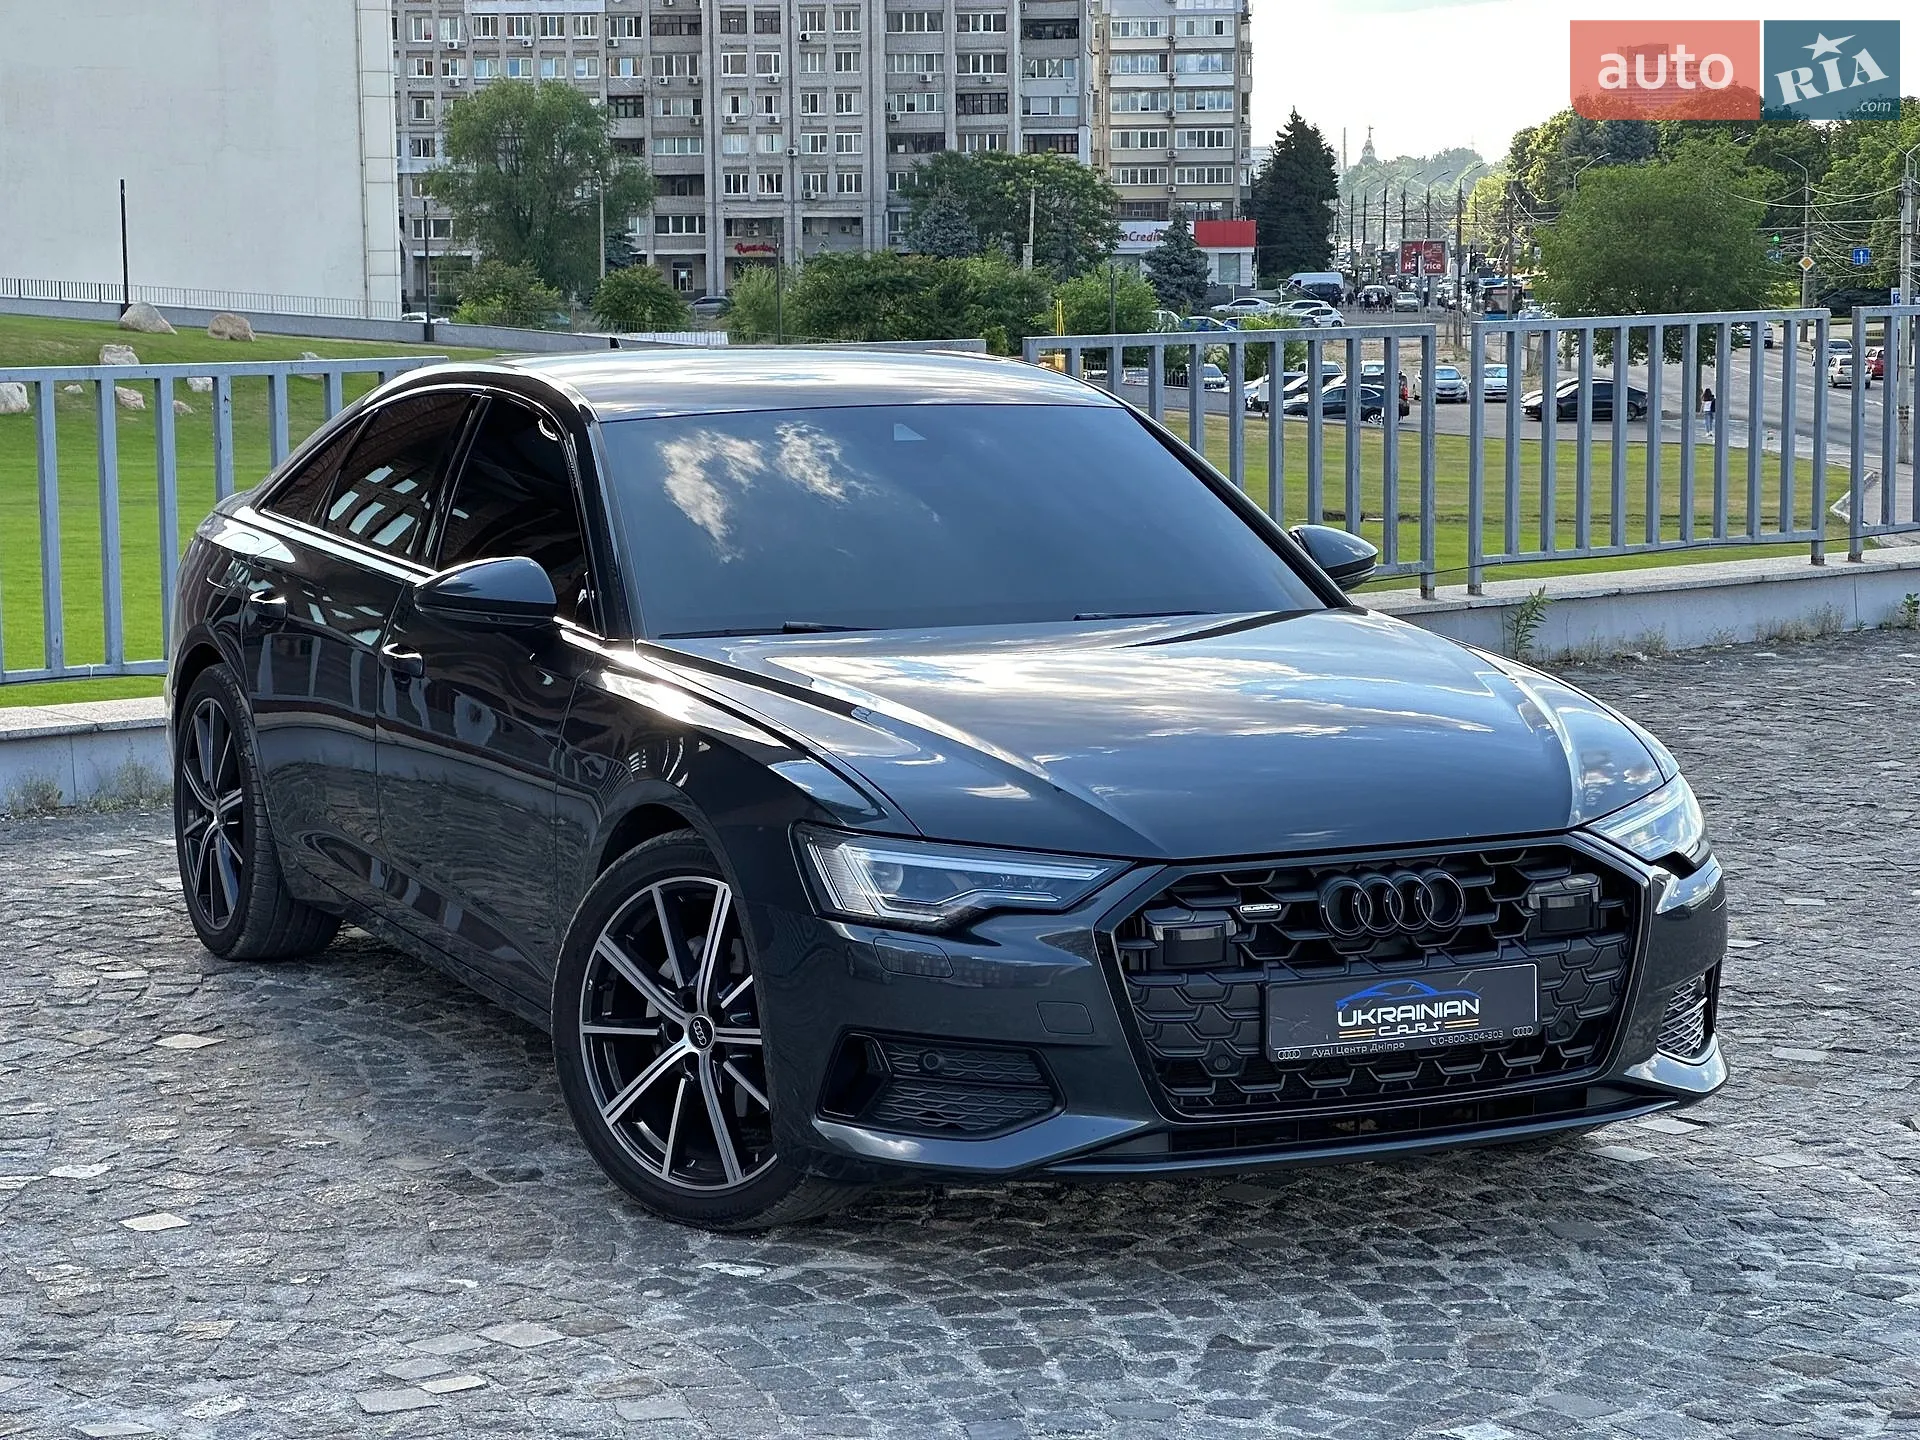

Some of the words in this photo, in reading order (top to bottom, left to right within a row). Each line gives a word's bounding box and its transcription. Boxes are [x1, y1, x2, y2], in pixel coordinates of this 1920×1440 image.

[1337, 998, 1480, 1027] UKRAINIAN
[1378, 1021, 1442, 1036] CARS
[1438, 1030, 1504, 1044] 0-800-304-303
[1311, 1047, 1333, 1057] Ауді
[1336, 1045, 1367, 1055] Центр
[1370, 1042, 1405, 1053] Дніпро
